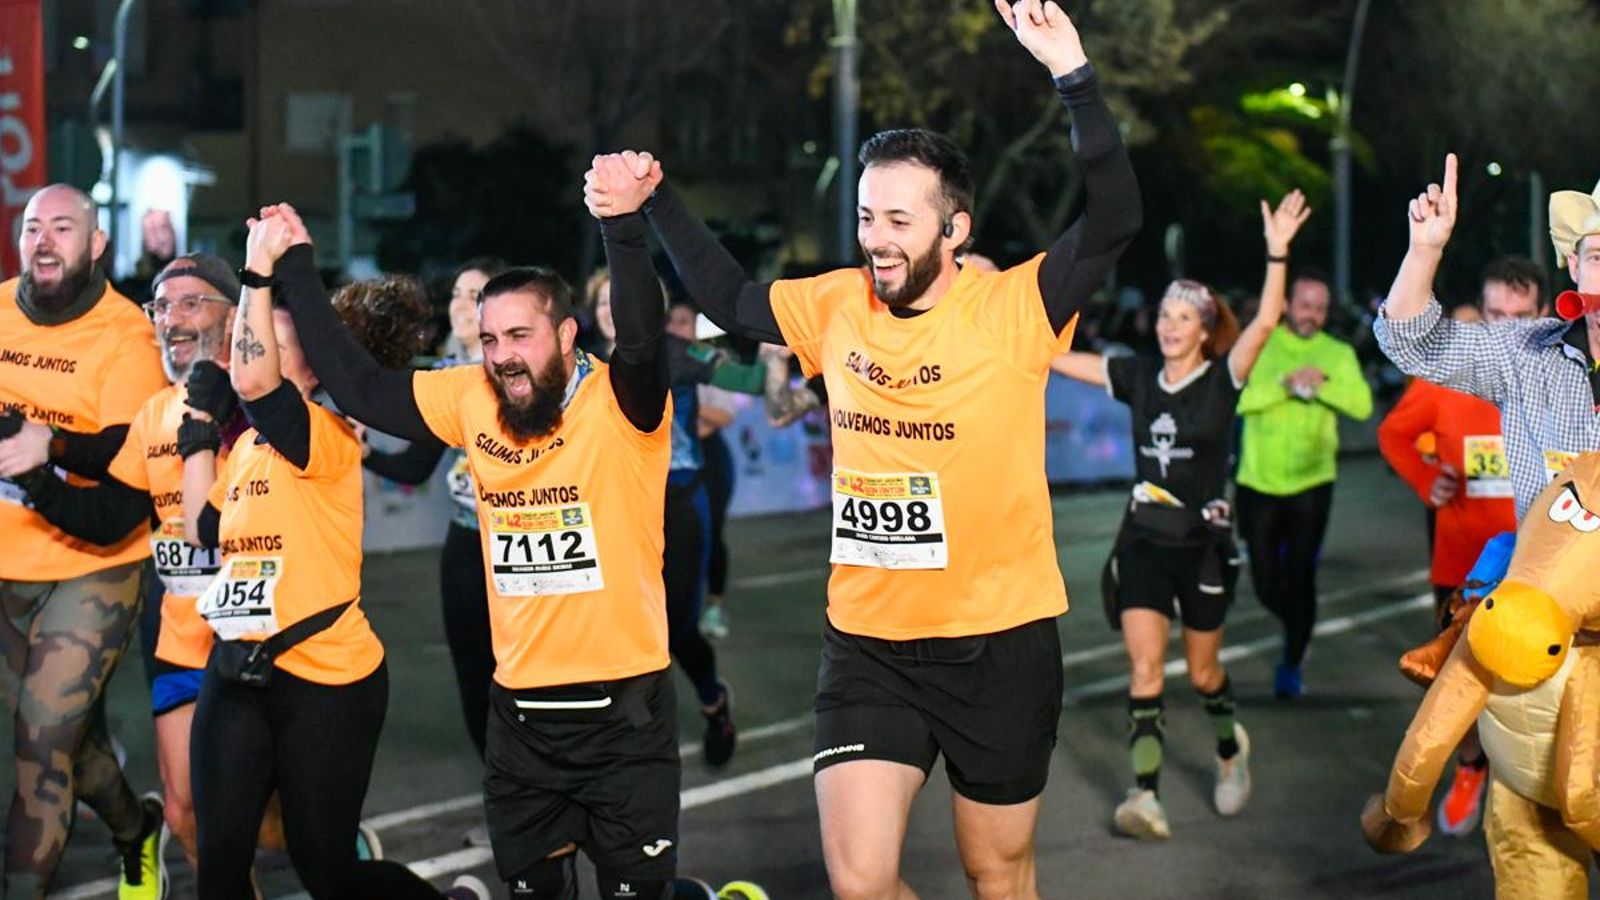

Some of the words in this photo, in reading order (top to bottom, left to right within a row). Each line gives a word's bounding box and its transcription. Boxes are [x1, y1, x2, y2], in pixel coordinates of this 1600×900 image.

[33, 356, 77, 373] JUNTOS
[31, 406, 74, 424] JUNTOS
[895, 420, 955, 441] JUNTOS
[1472, 453, 1503, 475] 35
[529, 485, 579, 506] JUNTOS
[506, 514, 521, 528] 42
[841, 497, 932, 532] 4998
[497, 531, 586, 563] 7112
